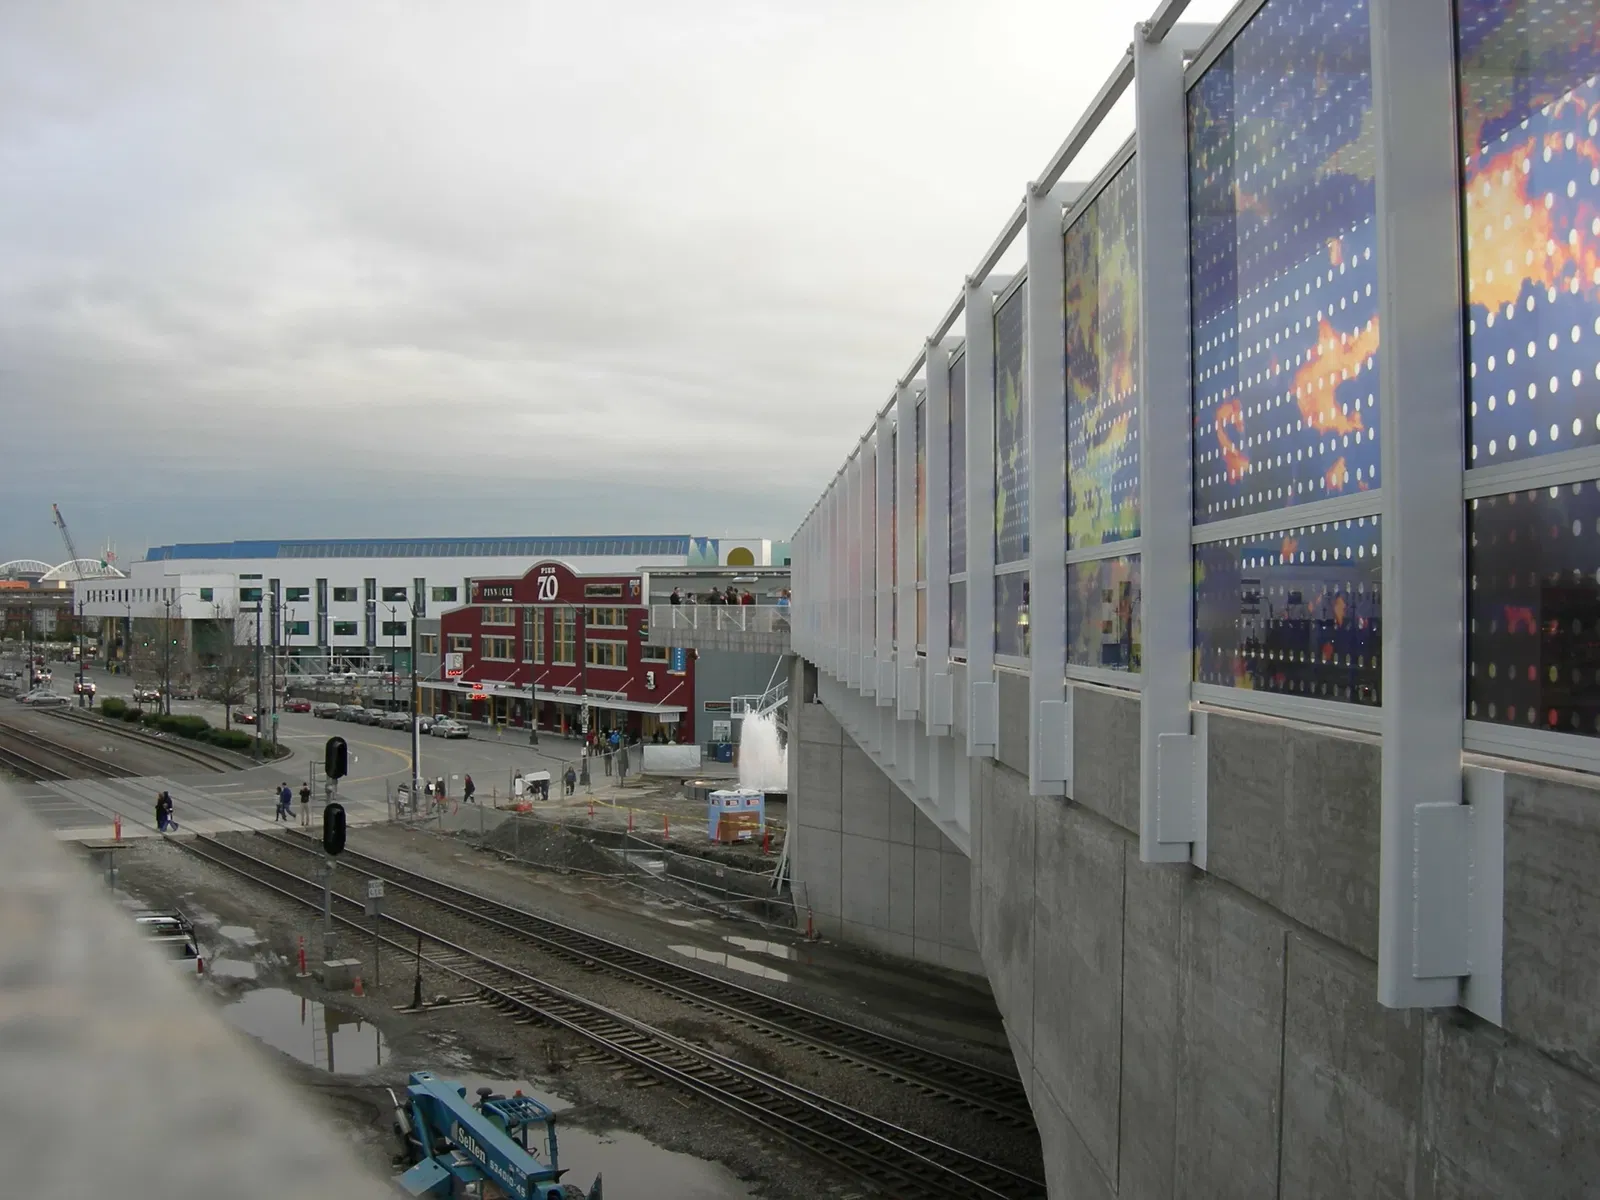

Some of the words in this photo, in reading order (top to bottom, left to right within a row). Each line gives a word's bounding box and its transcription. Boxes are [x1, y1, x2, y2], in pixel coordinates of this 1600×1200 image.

[483, 587, 513, 597] PINNACLE
[537, 575, 559, 601] 70
[458, 1127, 486, 1164] Sellen
